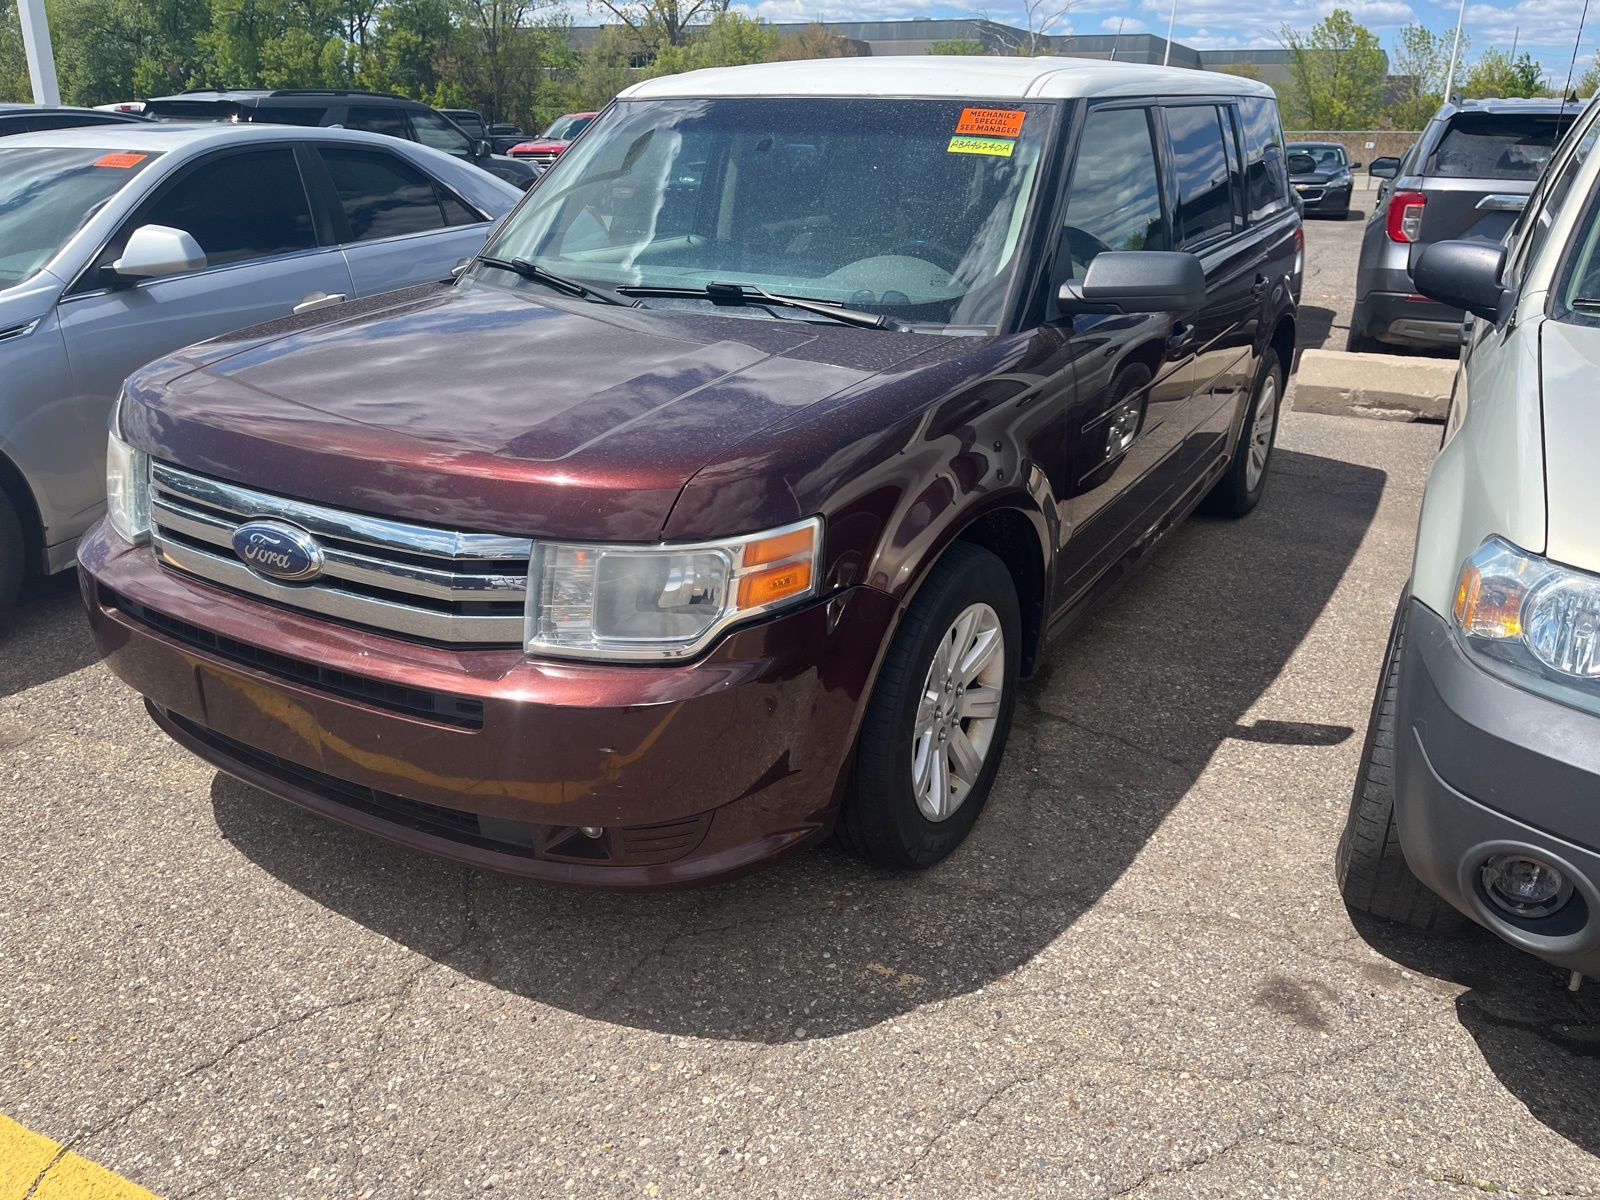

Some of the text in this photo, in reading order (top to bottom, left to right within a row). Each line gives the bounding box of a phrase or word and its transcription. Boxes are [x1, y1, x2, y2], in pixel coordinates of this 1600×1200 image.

[970, 111, 1017, 119] MECHANICS
[976, 125, 1018, 133] MANAGER
[244, 533, 291, 568] Ford
